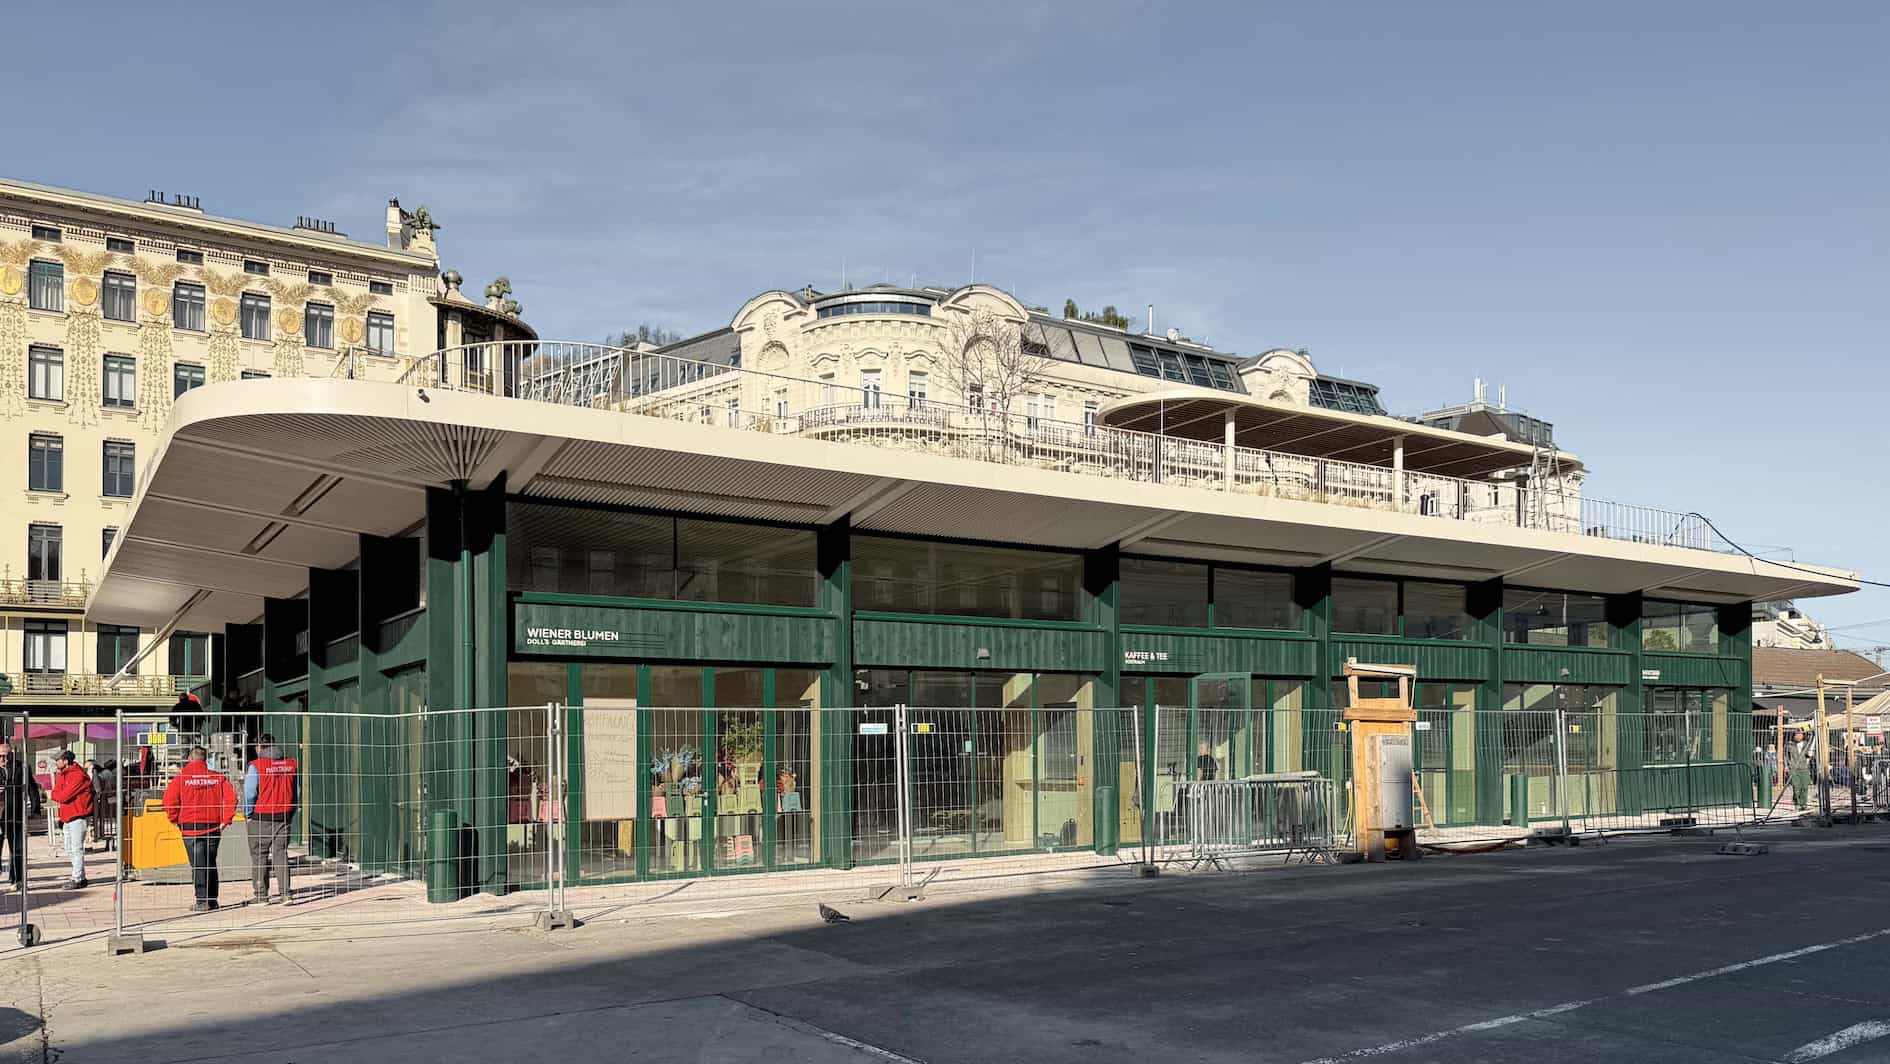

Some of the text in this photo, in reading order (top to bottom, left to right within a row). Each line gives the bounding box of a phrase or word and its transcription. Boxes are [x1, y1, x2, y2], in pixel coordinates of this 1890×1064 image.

[527, 628, 618, 641] WIENER BLUMEN
[1125, 651, 1149, 659] KAFFEE
[1156, 652, 1168, 660] TEE
